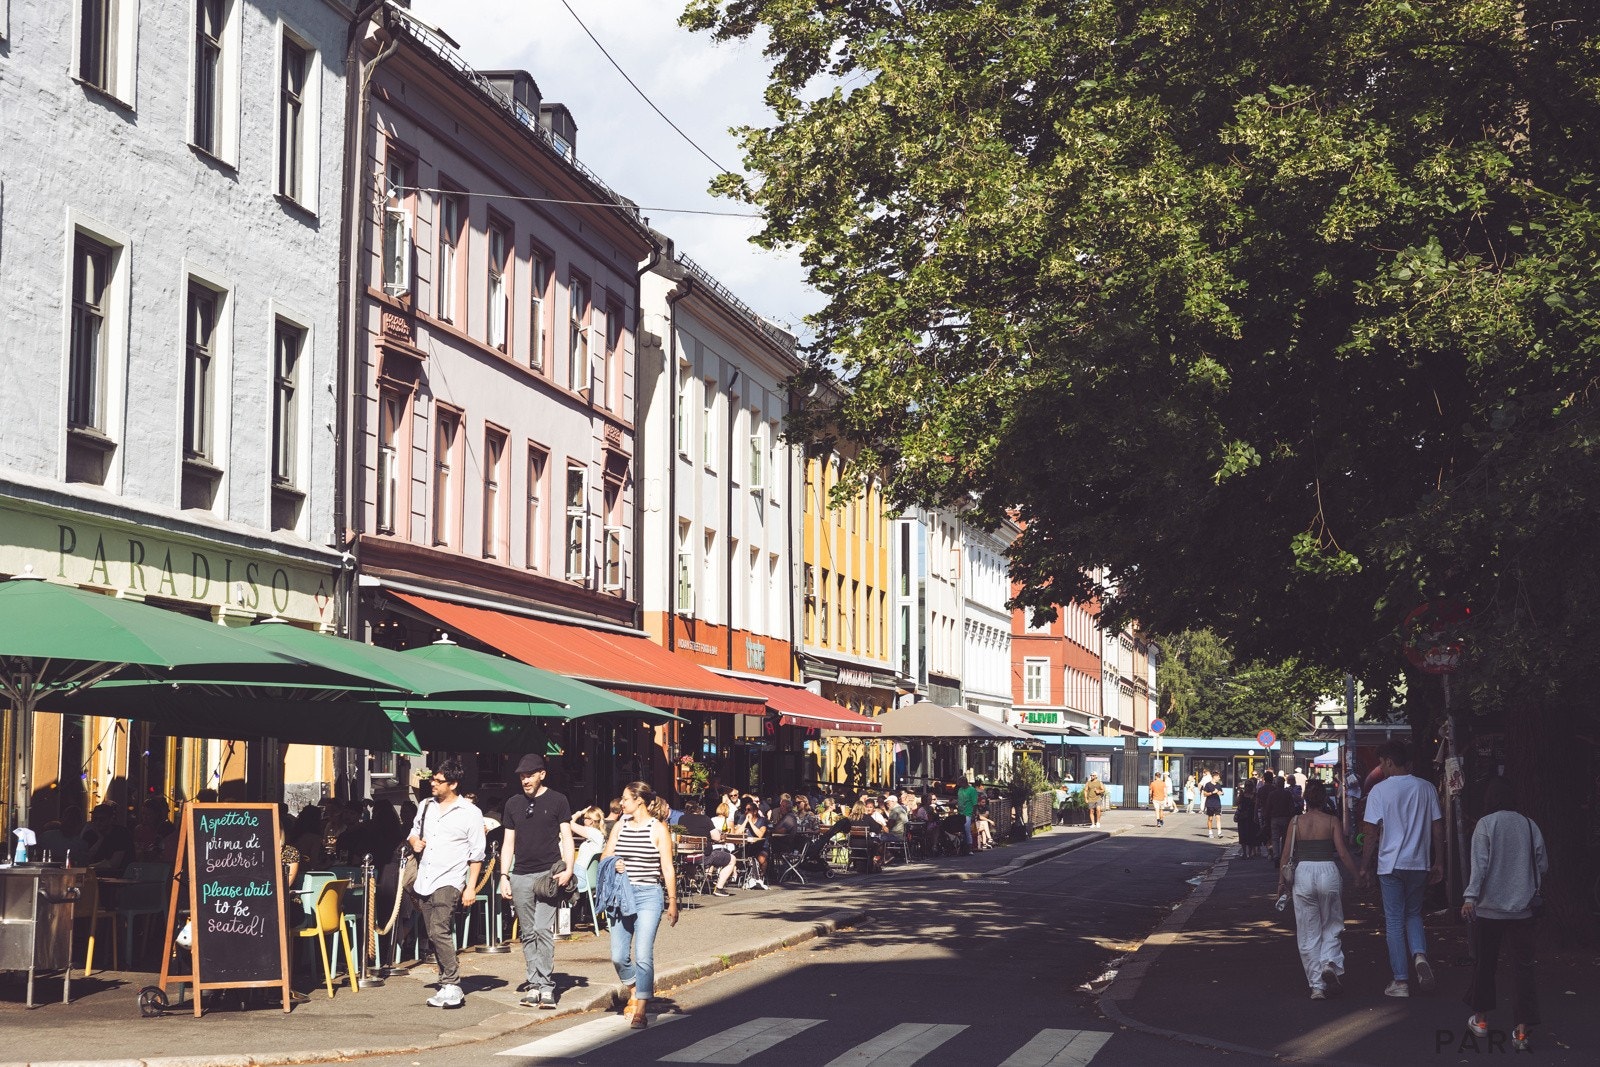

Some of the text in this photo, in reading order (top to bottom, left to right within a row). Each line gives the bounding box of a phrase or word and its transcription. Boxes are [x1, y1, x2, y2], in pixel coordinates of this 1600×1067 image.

[57, 524, 289, 613] PARADISO
[200, 811, 259, 836] Aspettare
[205, 833, 260, 860] prima di
[244, 881, 273, 897] wait
[215, 899, 251, 917] to be
